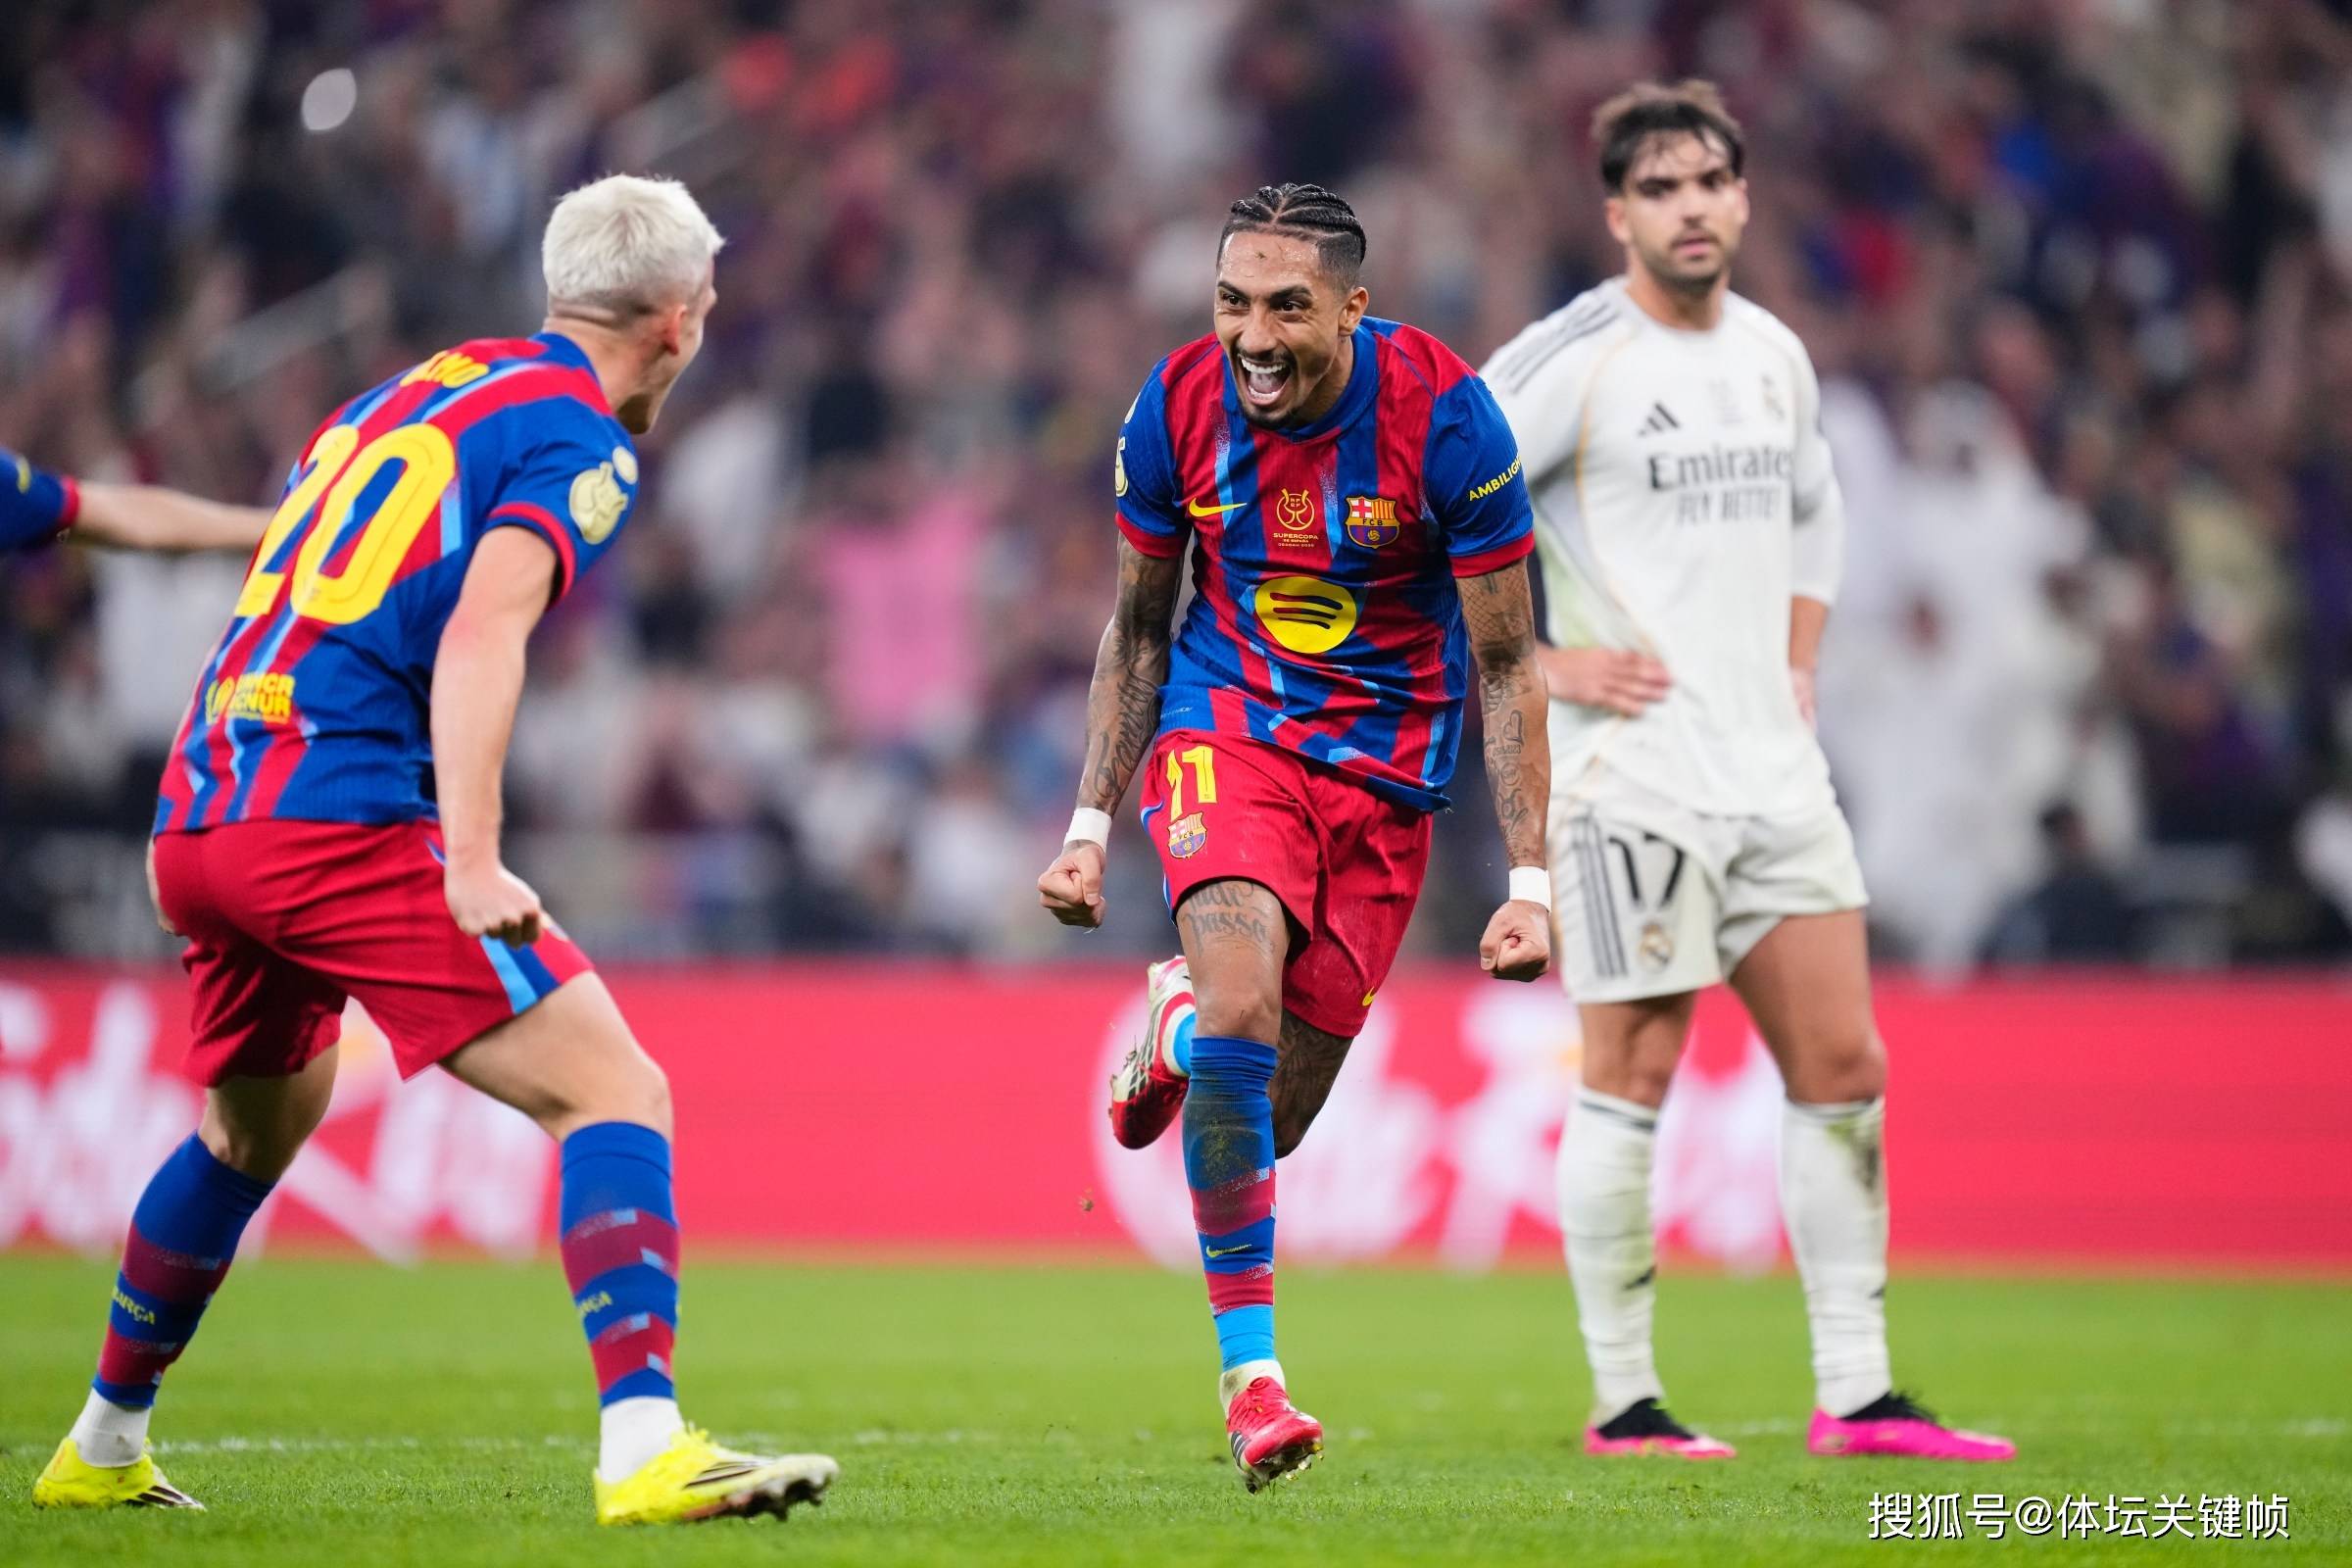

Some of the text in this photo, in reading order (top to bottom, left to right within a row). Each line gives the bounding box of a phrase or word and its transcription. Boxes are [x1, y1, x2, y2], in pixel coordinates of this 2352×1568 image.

[1648, 444, 1792, 491] Emirate
[1722, 489, 1774, 522] BETTE
[234, 423, 455, 624] 20
[1166, 745, 1217, 821] 11
[1608, 831, 1686, 907] 17
